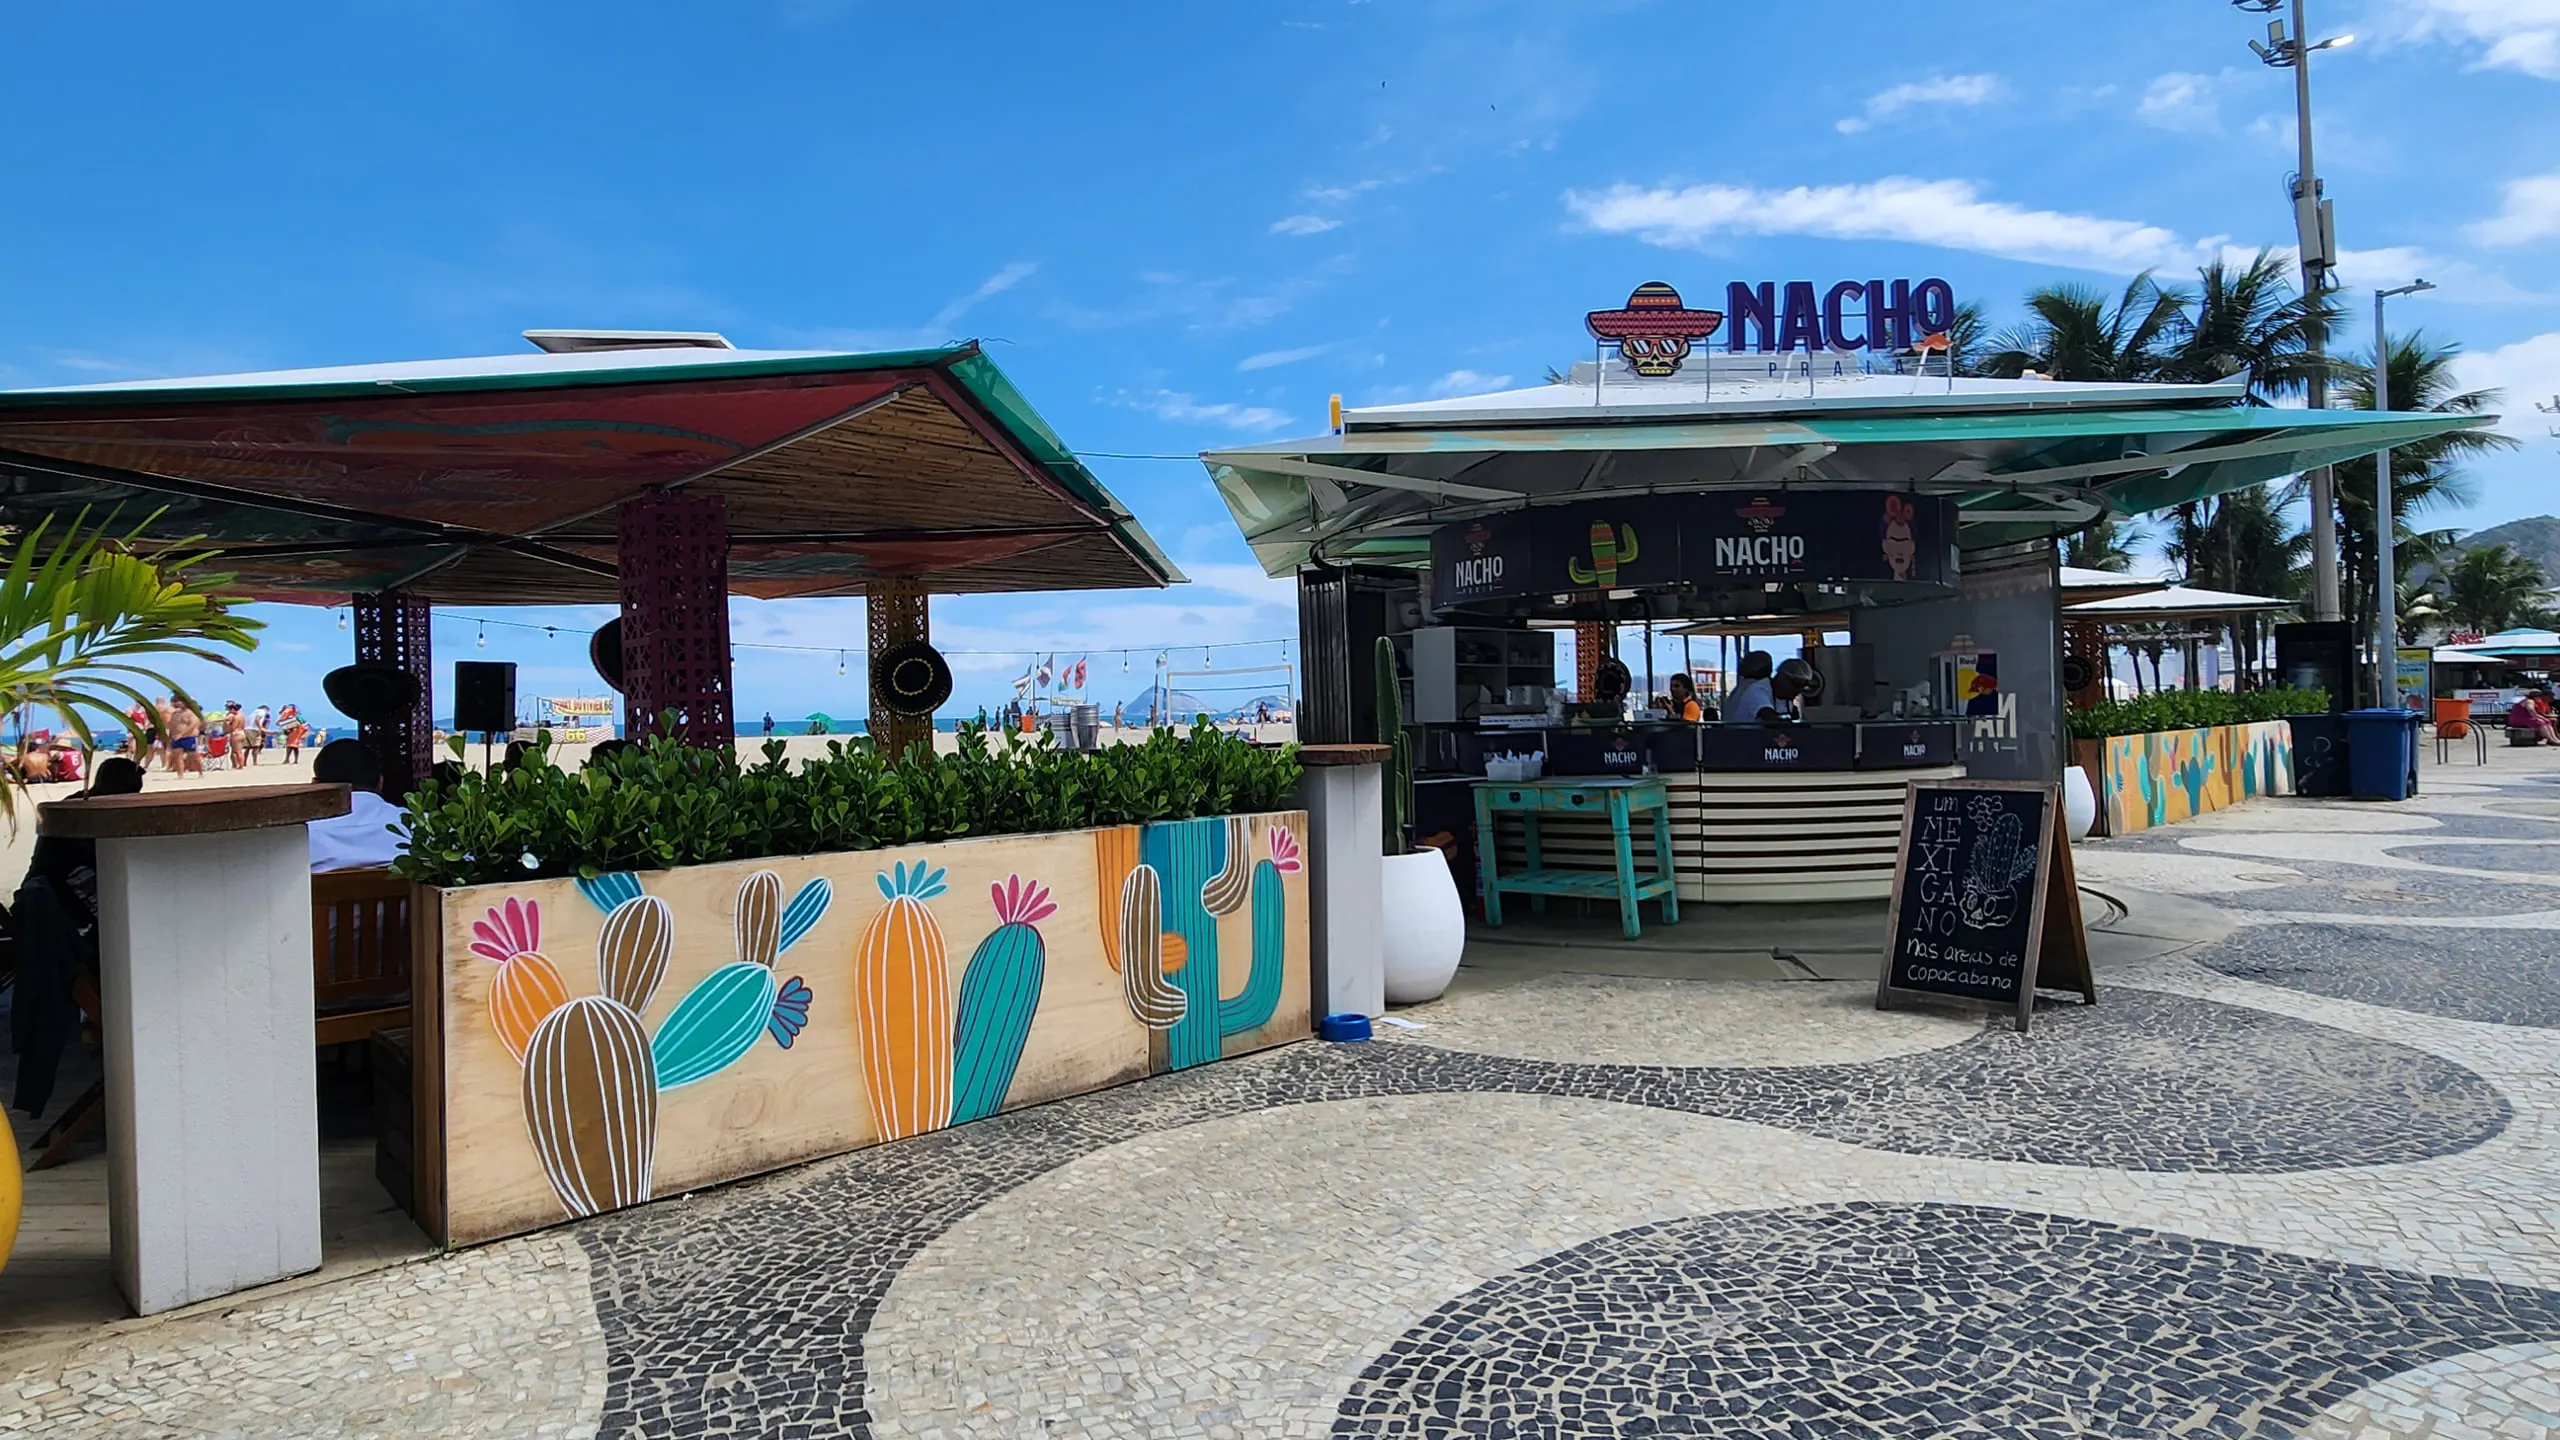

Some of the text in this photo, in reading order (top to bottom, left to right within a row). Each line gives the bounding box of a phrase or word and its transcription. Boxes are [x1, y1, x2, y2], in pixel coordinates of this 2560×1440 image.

[1726, 278, 1955, 354] NACHO
[1768, 360, 1905, 378] PRAIA
[1715, 535, 1805, 567] NACHO
[1455, 555, 1503, 588] NACHO
[1604, 751, 1637, 764] NACHO
[1764, 747, 1799, 761] NACHO
[1903, 743, 1926, 757] NACHO
[1921, 815, 1962, 844] ME
[1914, 842, 1957, 875] XI
[1913, 906, 1957, 937] NO
[1999, 949, 2018, 967] de
